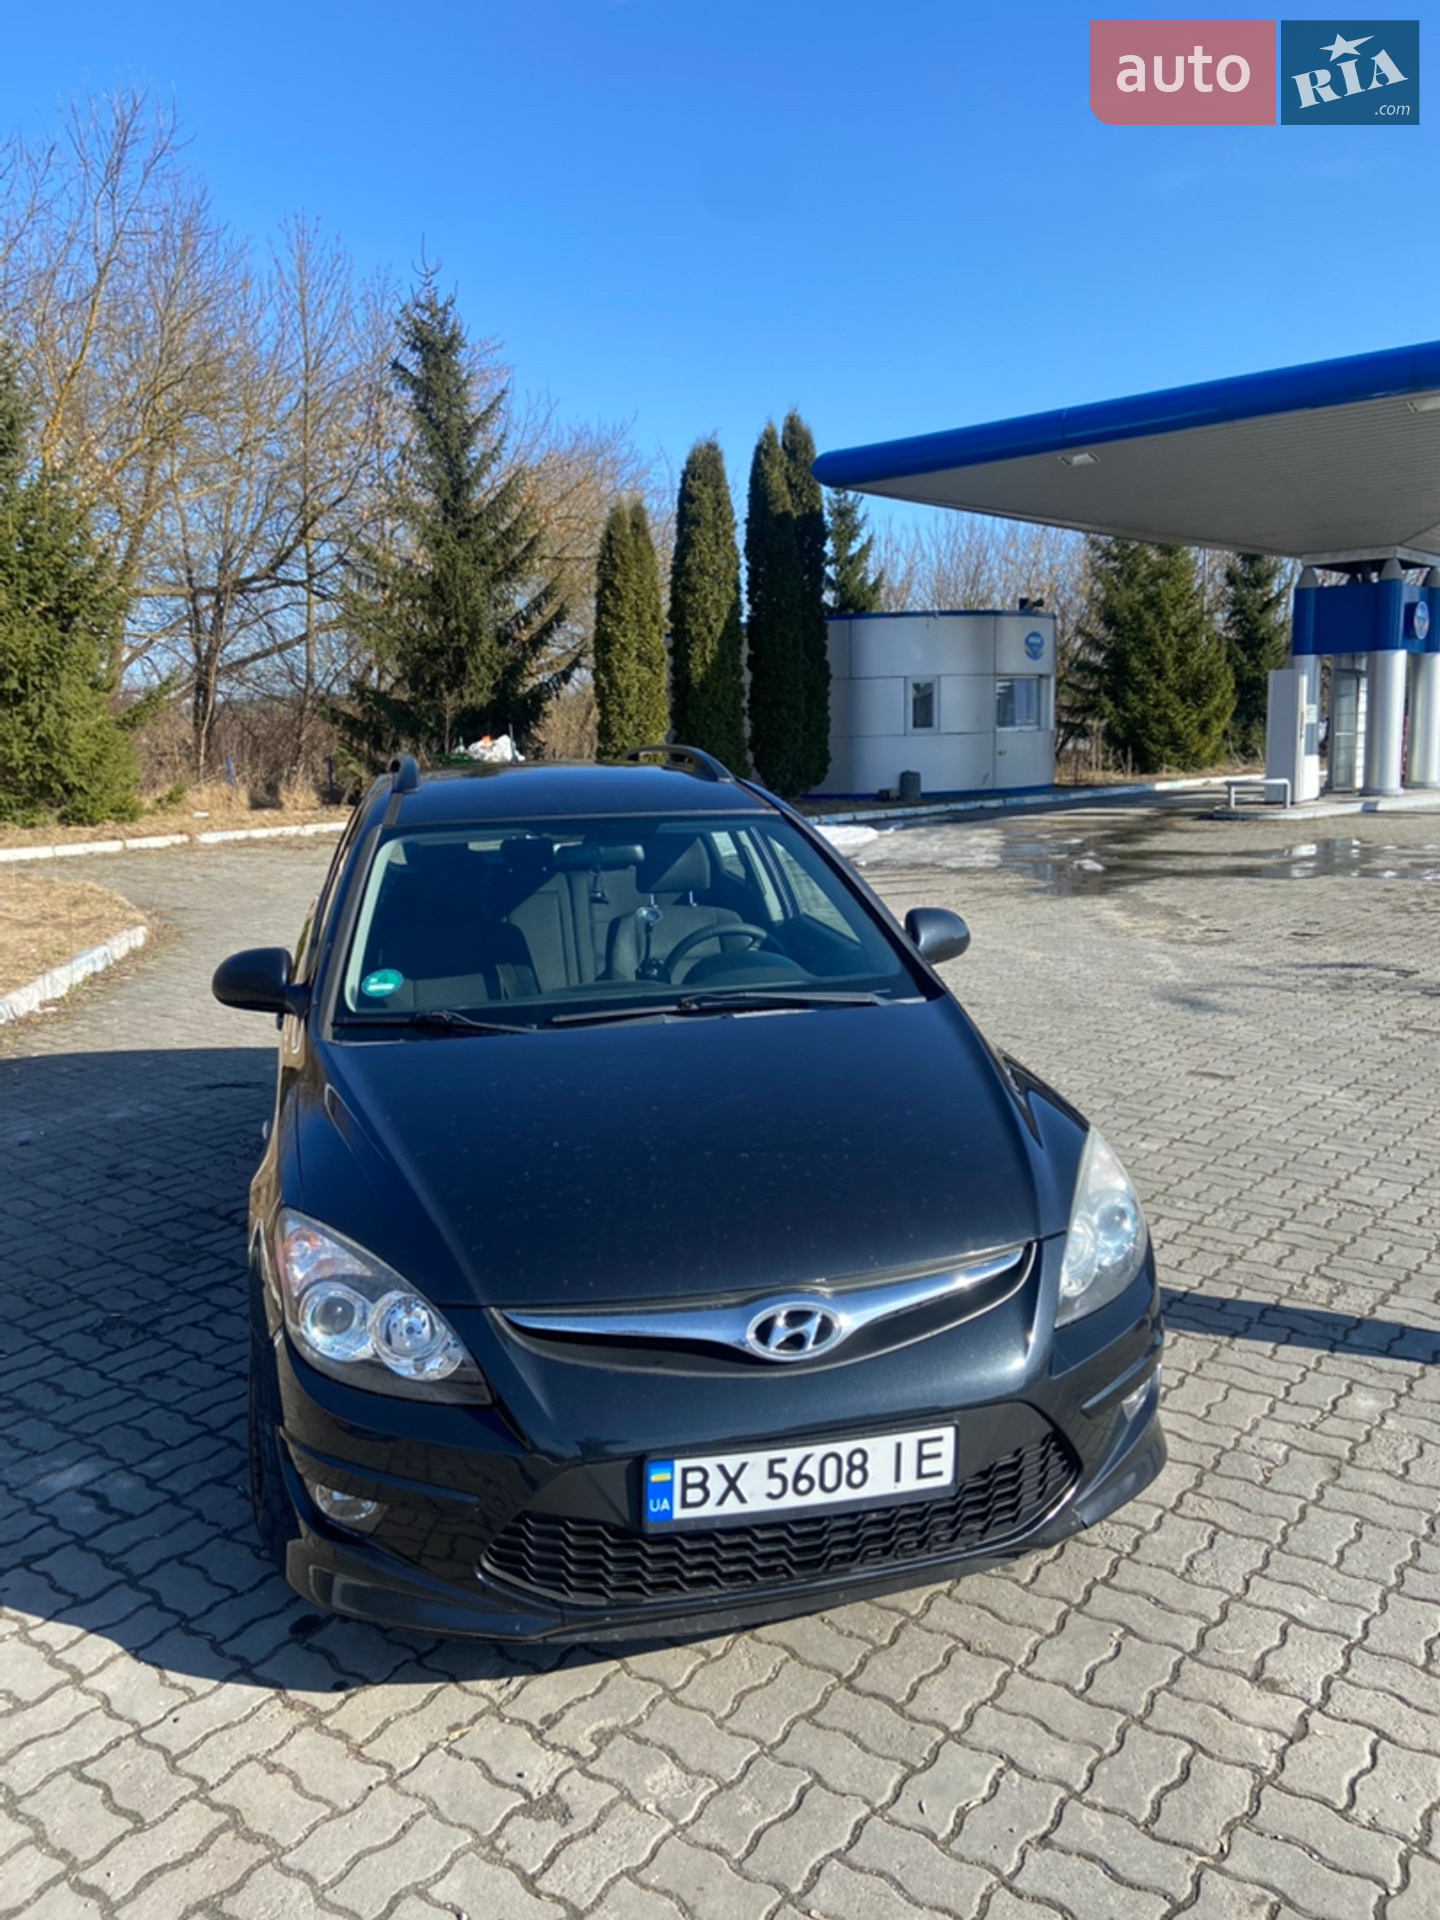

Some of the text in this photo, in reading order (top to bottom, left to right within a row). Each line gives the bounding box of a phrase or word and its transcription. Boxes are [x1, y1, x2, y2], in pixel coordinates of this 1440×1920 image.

[680, 1435, 945, 1510] BX 5608 IE
[649, 1497, 671, 1513] UA
